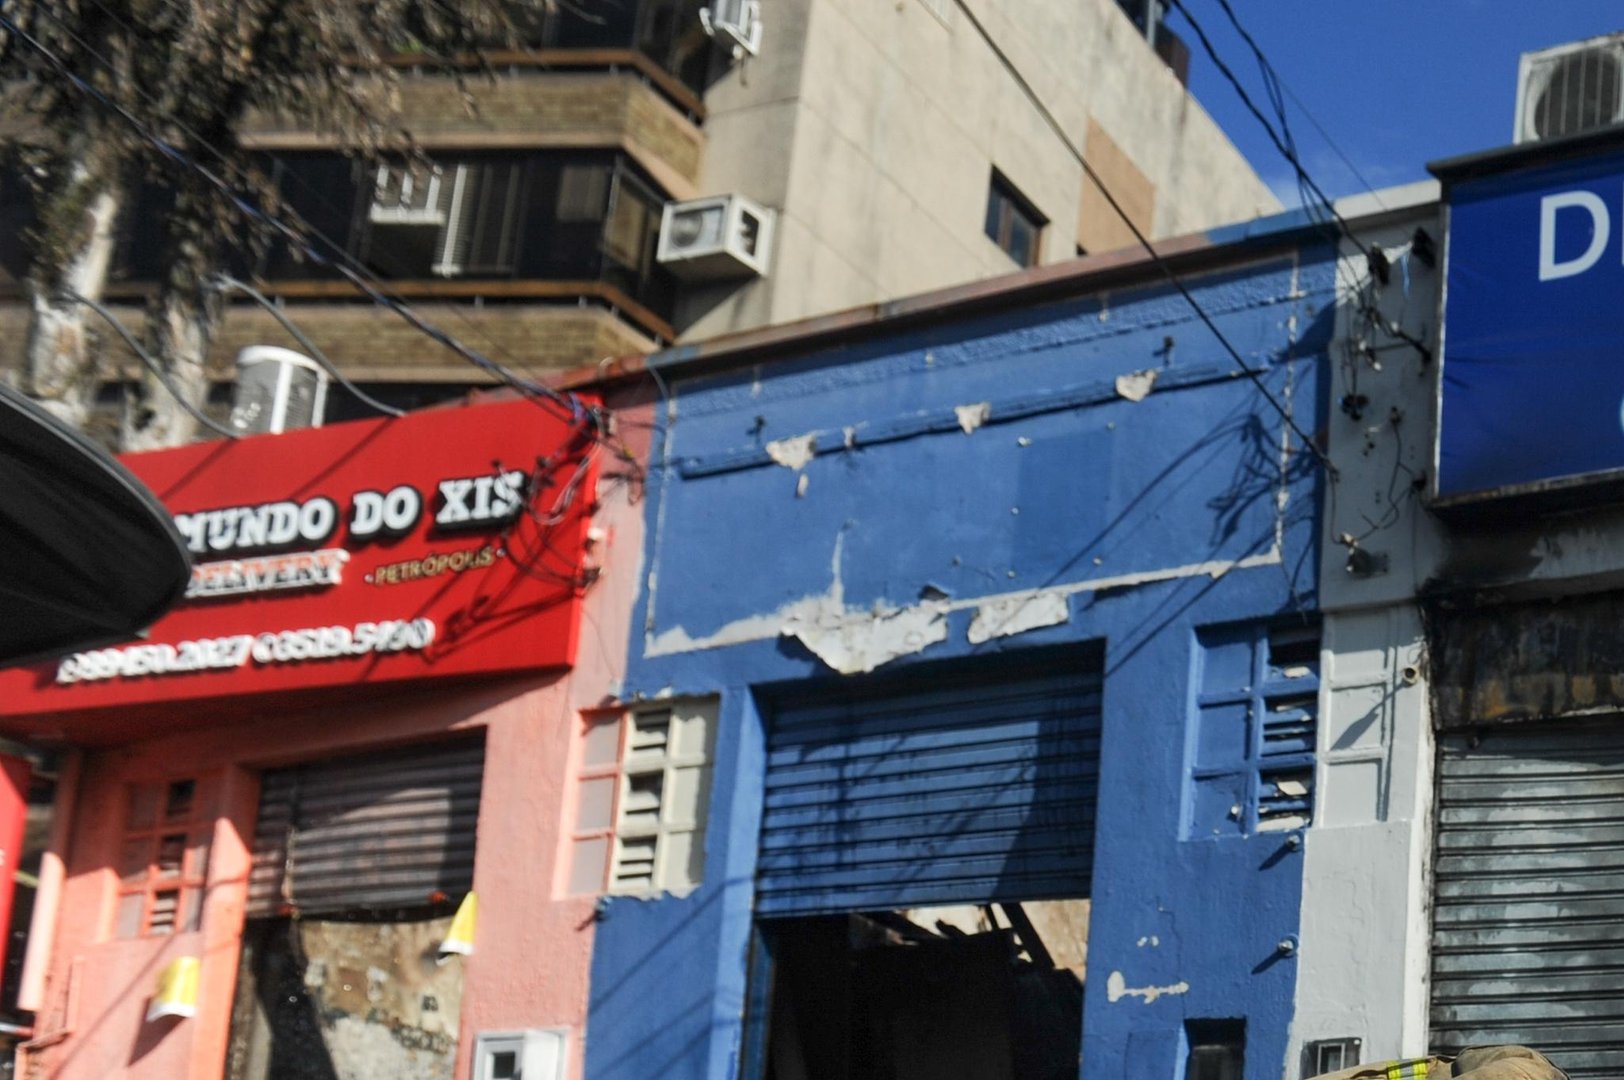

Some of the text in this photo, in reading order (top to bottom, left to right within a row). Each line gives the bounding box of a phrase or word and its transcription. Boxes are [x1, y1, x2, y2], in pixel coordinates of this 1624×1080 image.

[173, 470, 525, 552] MUNDO DO XIS
[375, 545, 494, 586] PETRÓPOLIS
